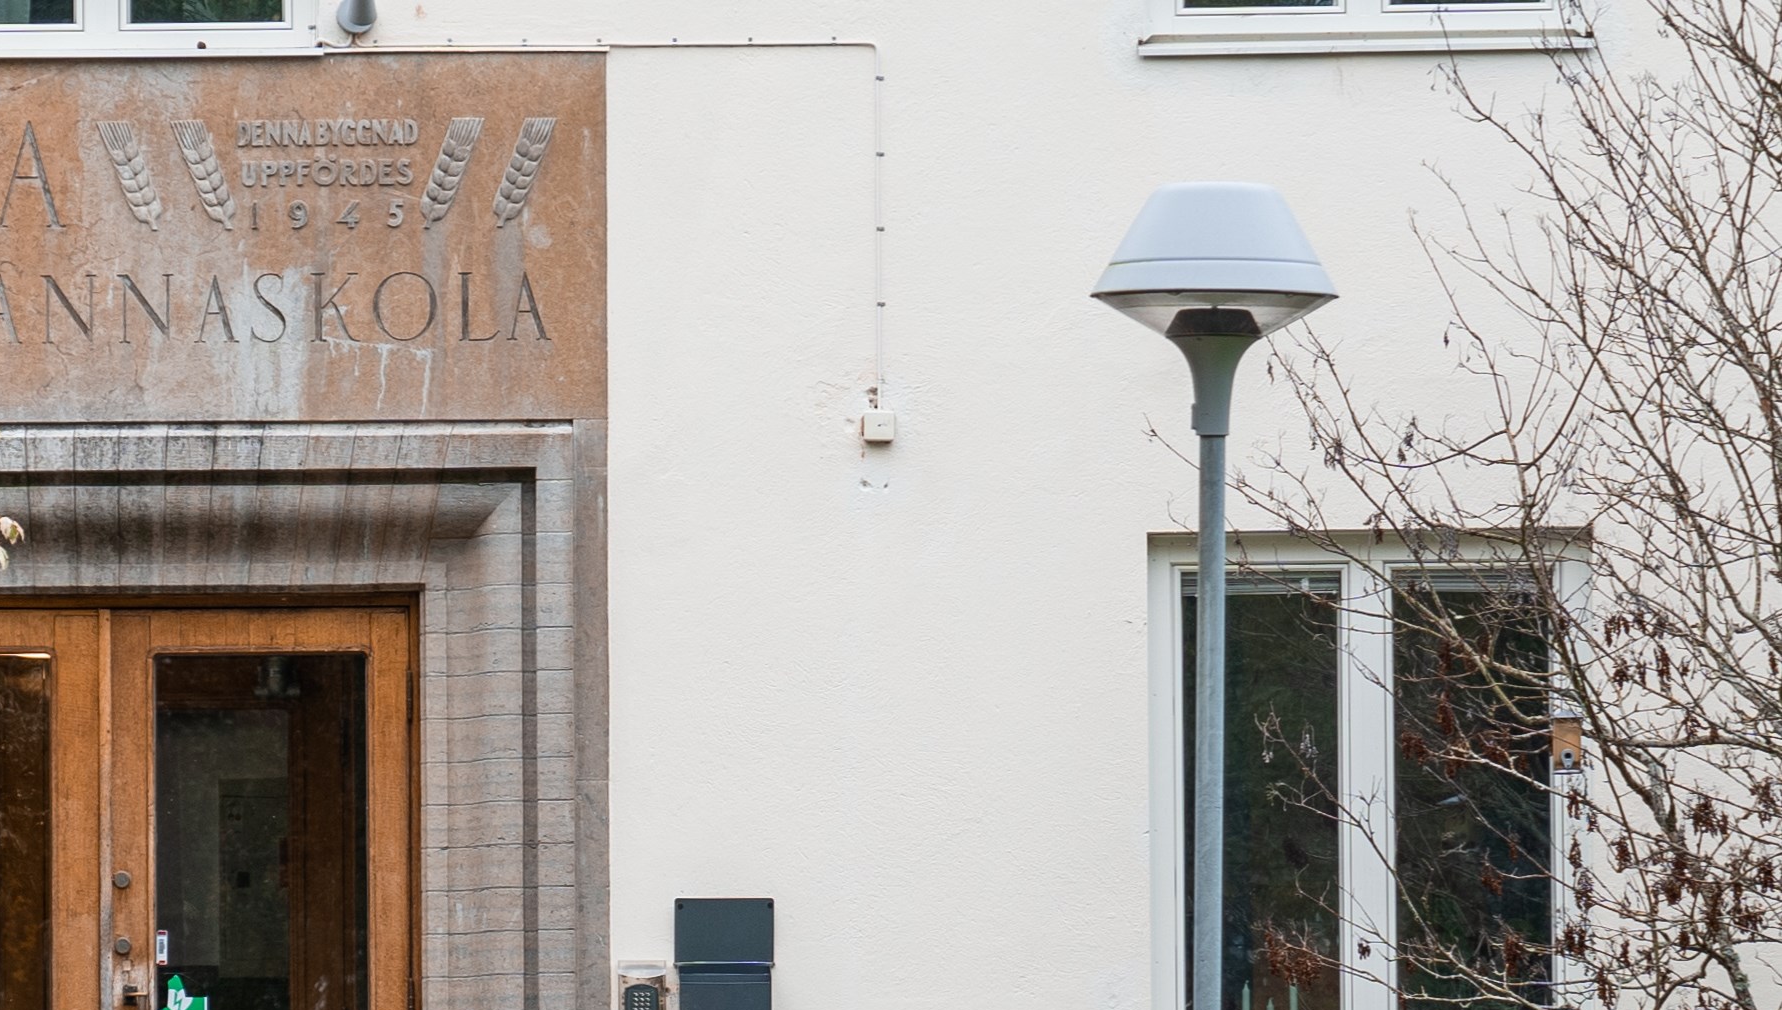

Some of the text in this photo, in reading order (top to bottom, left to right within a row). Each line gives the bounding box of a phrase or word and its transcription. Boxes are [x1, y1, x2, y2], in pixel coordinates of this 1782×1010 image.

[236, 118, 419, 147] DENNA BYGGNAD
[240, 153, 415, 188] UPPFÖRDES
[250, 199, 405, 230] 1945
